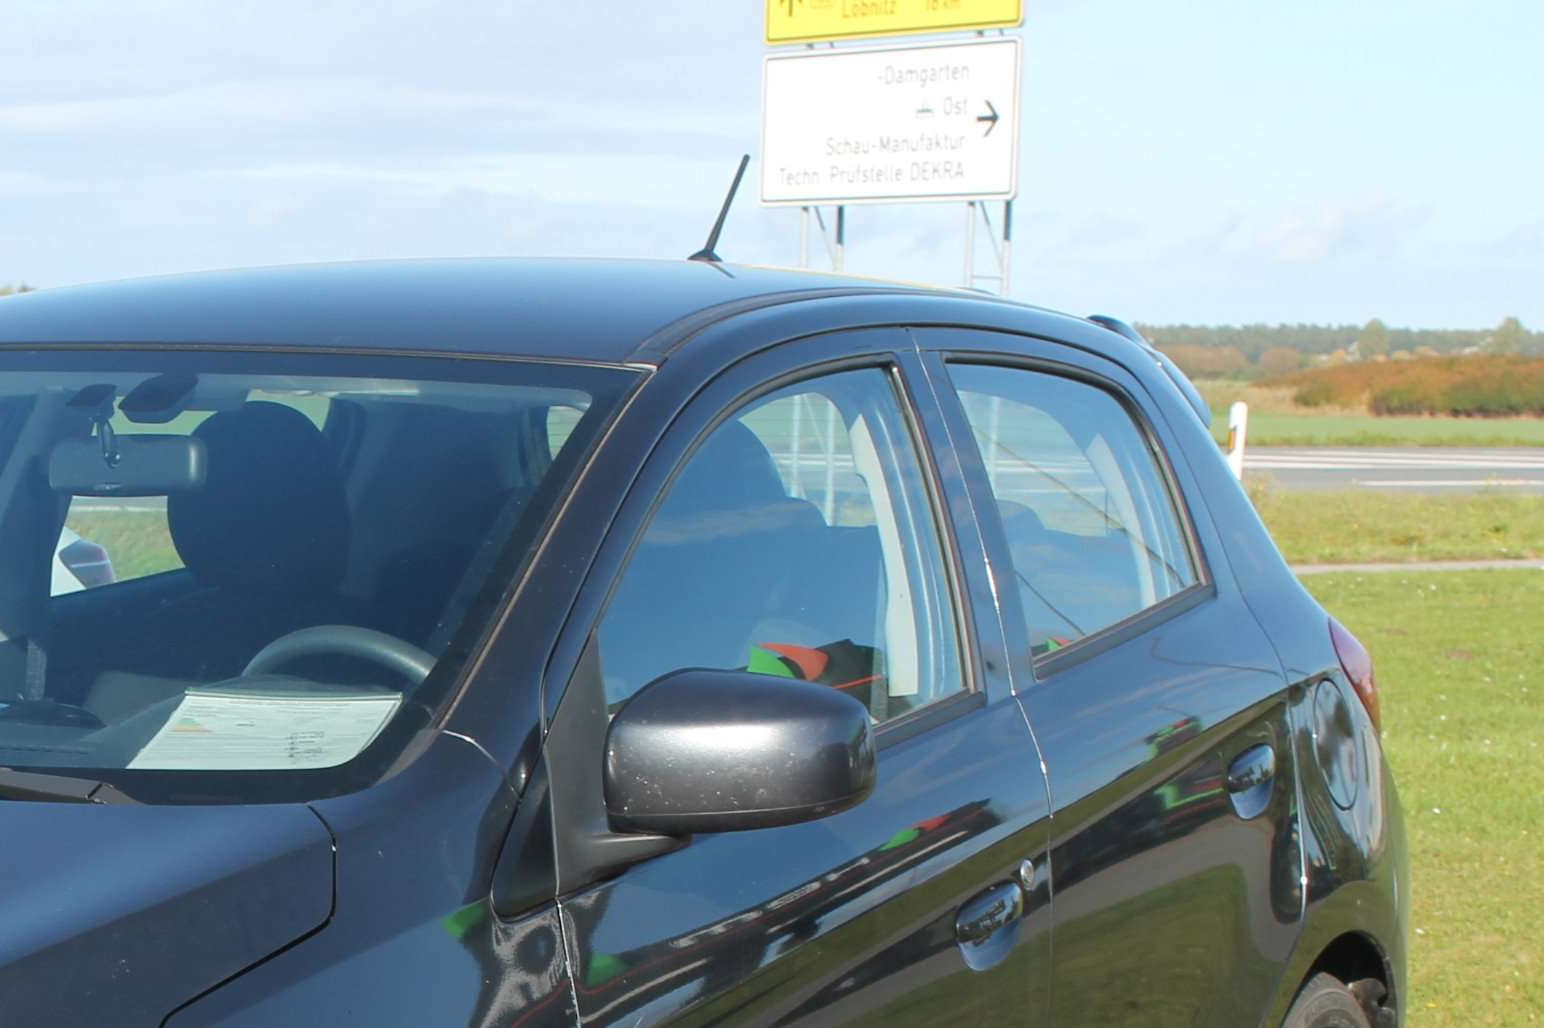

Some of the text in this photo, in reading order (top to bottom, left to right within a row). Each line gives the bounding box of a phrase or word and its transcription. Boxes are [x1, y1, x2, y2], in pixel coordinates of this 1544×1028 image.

[943, 96, 968, 116] Ost
[826, 133, 966, 156] Schau-Manufaktur
[910, 160, 965, 182] DEKRA
